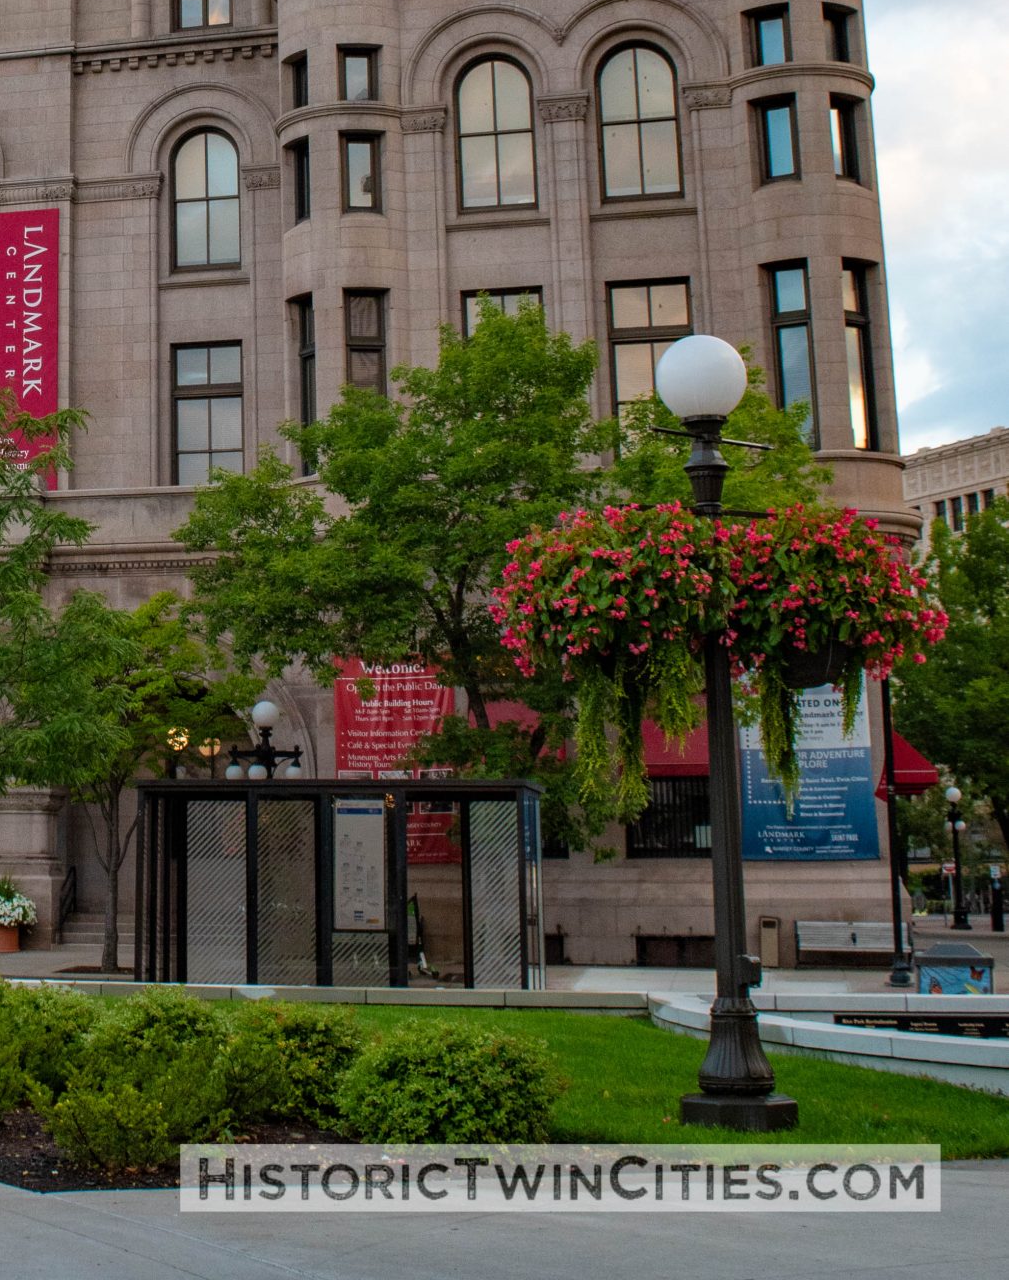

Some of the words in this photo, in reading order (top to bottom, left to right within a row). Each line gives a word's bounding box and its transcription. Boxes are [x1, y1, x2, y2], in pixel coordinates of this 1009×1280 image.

[5, 246, 17, 379] CENTER
[22, 224, 48, 399] LANDMARK
[396, 681, 423, 692] Public
[383, 699, 411, 709] Building
[412, 698, 434, 707] Hours
[347, 729, 368, 737] Visitor
[370, 729, 409, 737] Information
[347, 740, 363, 749] Café
[371, 740, 396, 751] Special
[382, 753, 396, 761] Arts
[810, 749, 866, 759] ADVENTURE
[348, 761, 372, 770] History
[757, 829, 806, 839] LANDMARK
